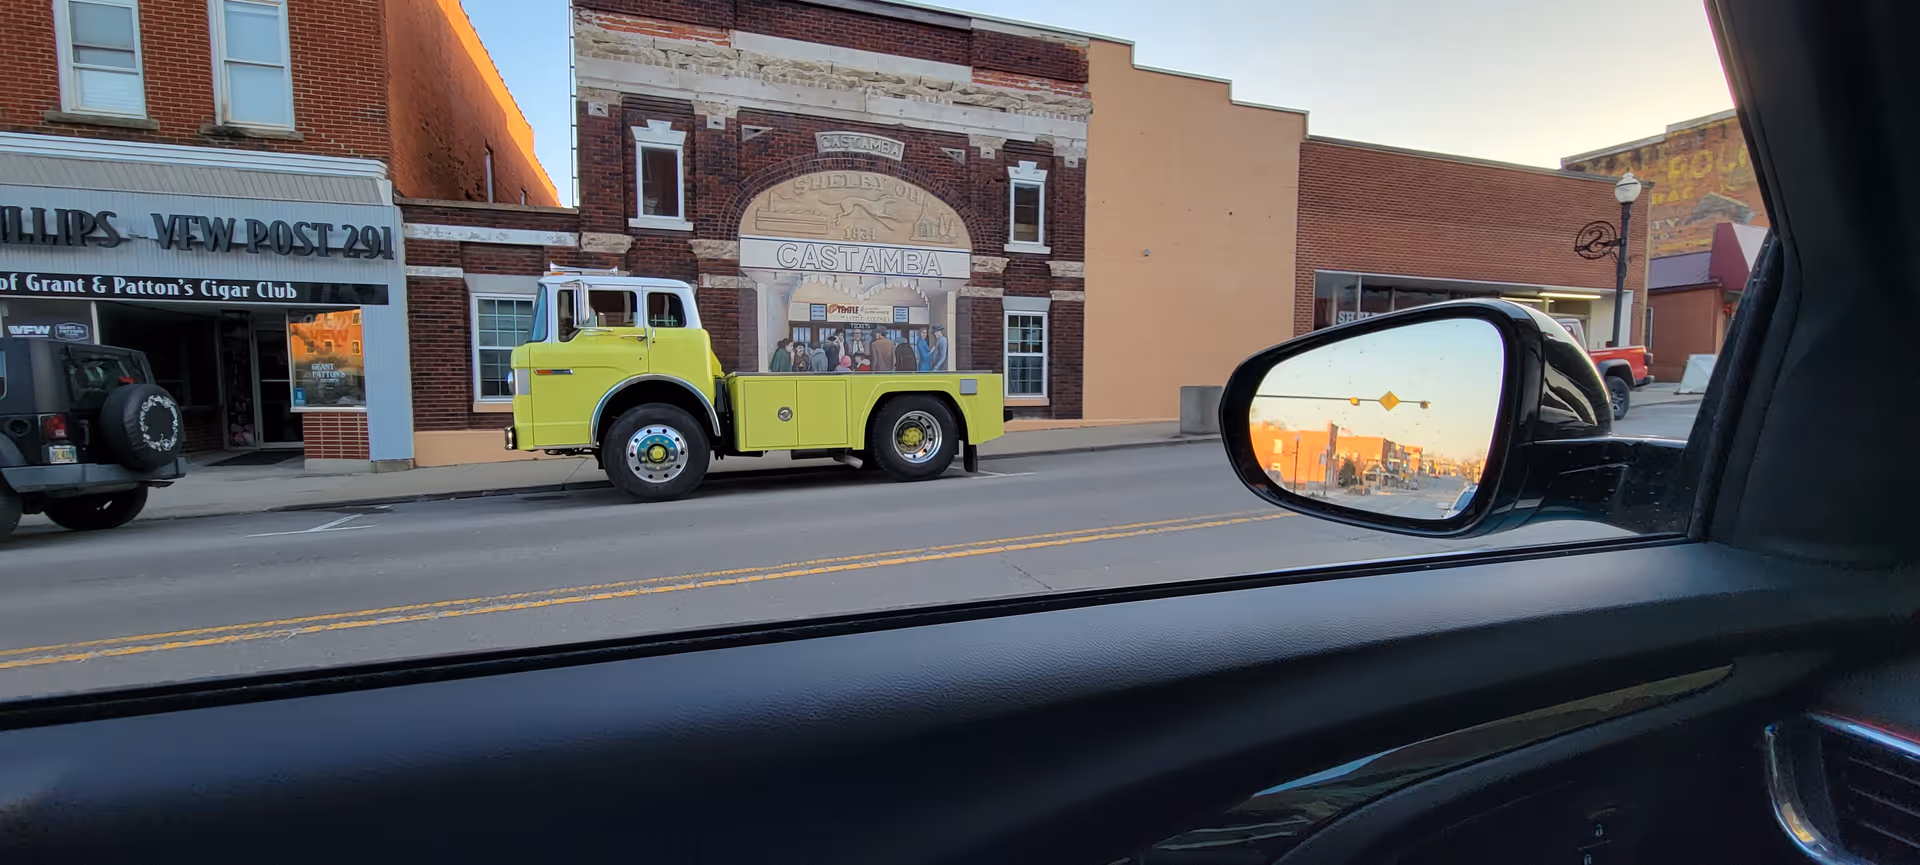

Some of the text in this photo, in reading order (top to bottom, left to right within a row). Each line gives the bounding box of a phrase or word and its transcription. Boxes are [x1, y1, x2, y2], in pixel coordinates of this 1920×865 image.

[820, 135, 900, 157] CASTAMBA
[793, 173, 886, 195] SHELBY
[150, 213, 236, 252] VFW
[245, 218, 333, 258] POST
[342, 224, 394, 260] 291
[777, 242, 942, 276] CASTAMBA
[0, 273, 297, 300] of Grant & Patton's Cigar Club
[837, 305, 859, 314] TEMPLE
[8, 325, 51, 335] VFW
